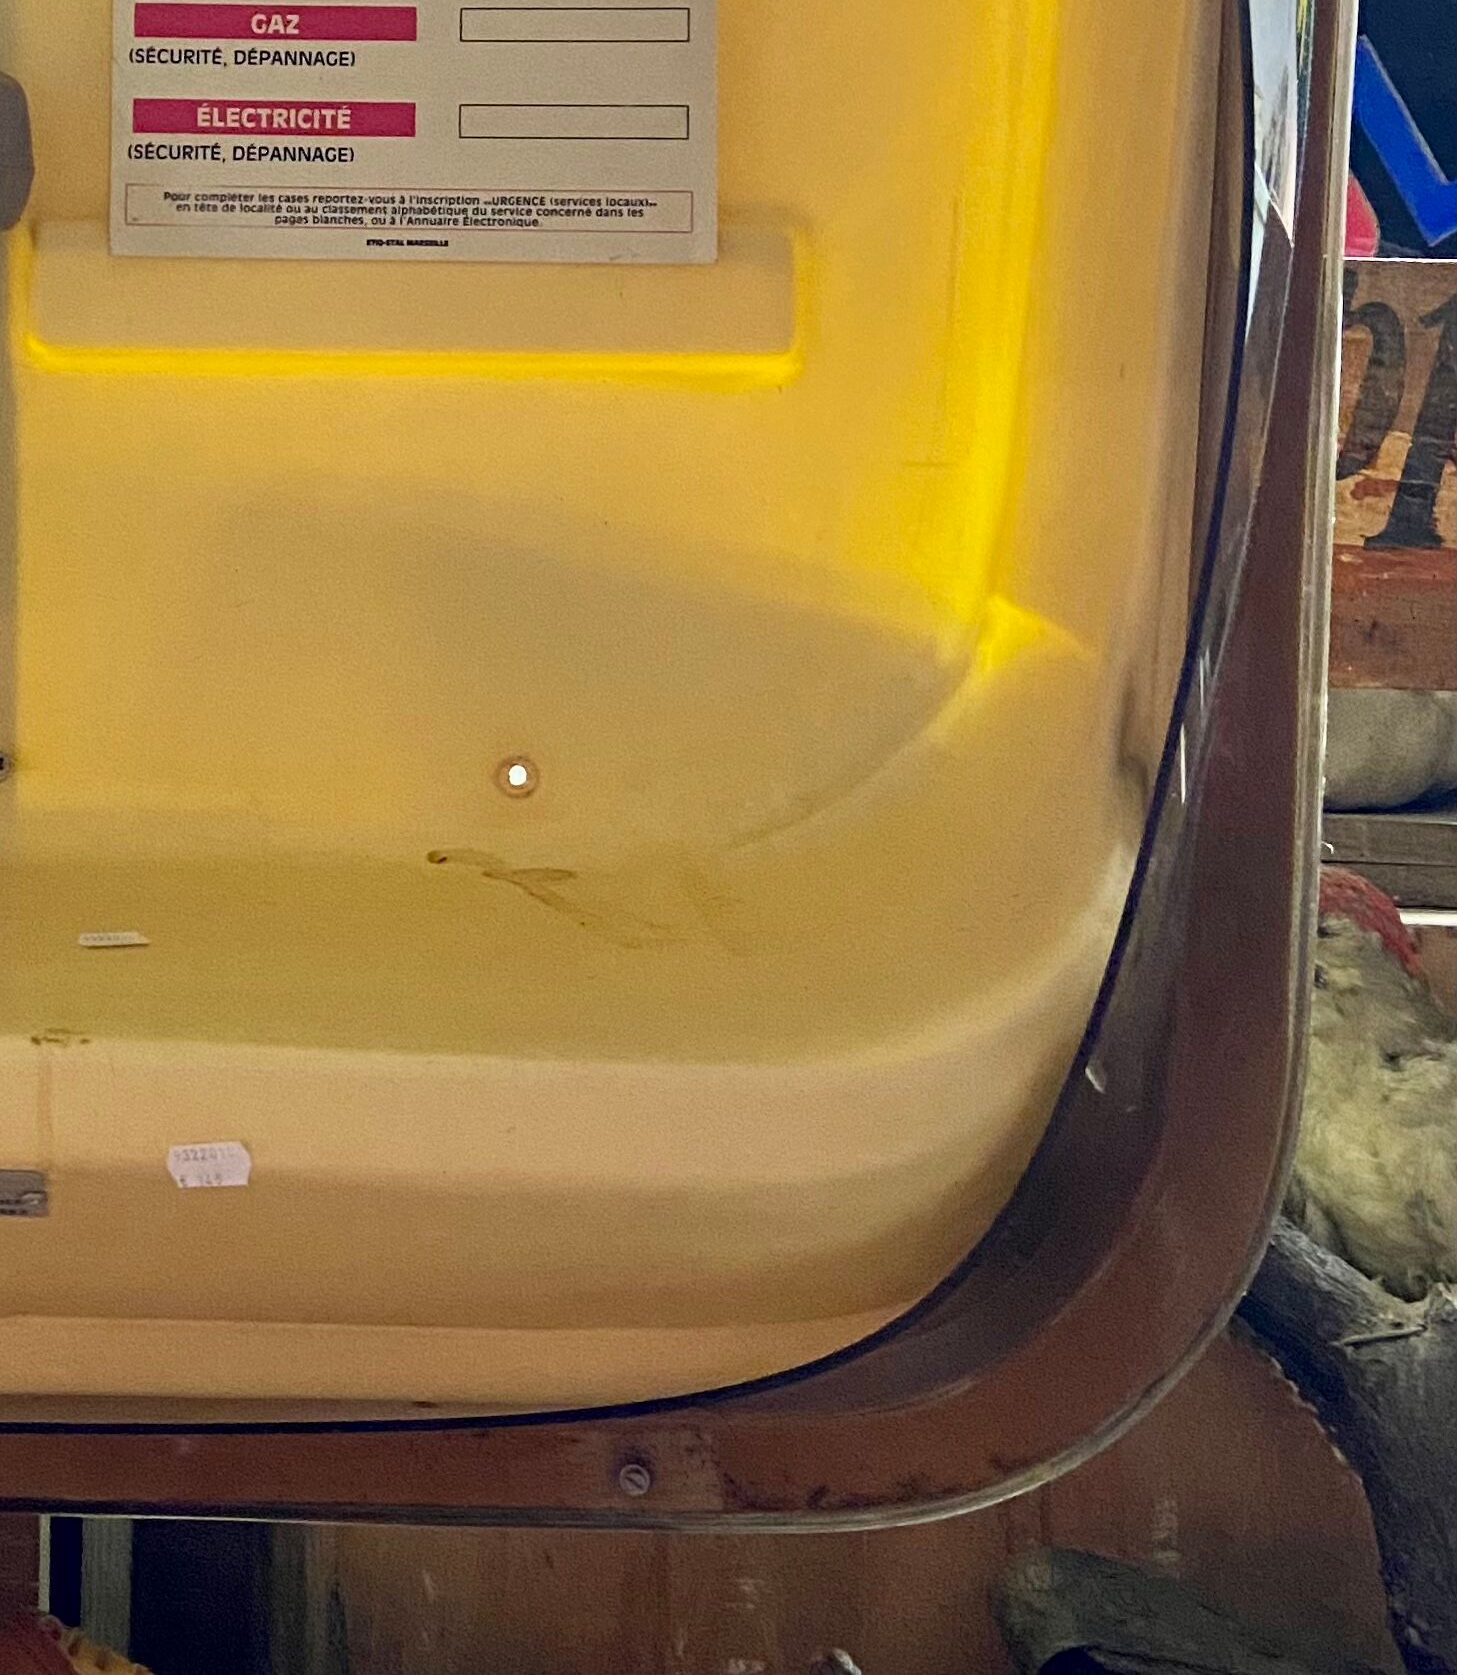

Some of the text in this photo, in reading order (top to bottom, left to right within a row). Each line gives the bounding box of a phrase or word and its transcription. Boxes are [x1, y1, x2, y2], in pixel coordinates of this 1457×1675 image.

[250, 13, 300, 35] GAZ
[128, 45, 356, 68] (SÉCURITÉ, DÉPANNAGE)
[197, 102, 352, 130] ÉLECTRICITÉ
[127, 141, 355, 164] (SÉCURITÉ, DÉPANNAGE)
[163, 191, 192, 202] Pour
[194, 192, 255, 204] compléter
[258, 193, 275, 204] les
[277, 194, 310, 204] cases
[312, 194, 396, 205] reportez-vous
[398, 195, 406, 205] à
[409, 195, 480, 207] l'inscription
[549, 197, 602, 208] (services
[175, 202, 644, 218] en tête de localité ou au classement alphabétique du service concerné dans les
[274, 215, 309, 226] pages
[312, 214, 368, 227] blanches,
[370, 216, 387, 226] ou
[389, 215, 396, 226] à
[399, 214, 460, 227] l'Annuaire
